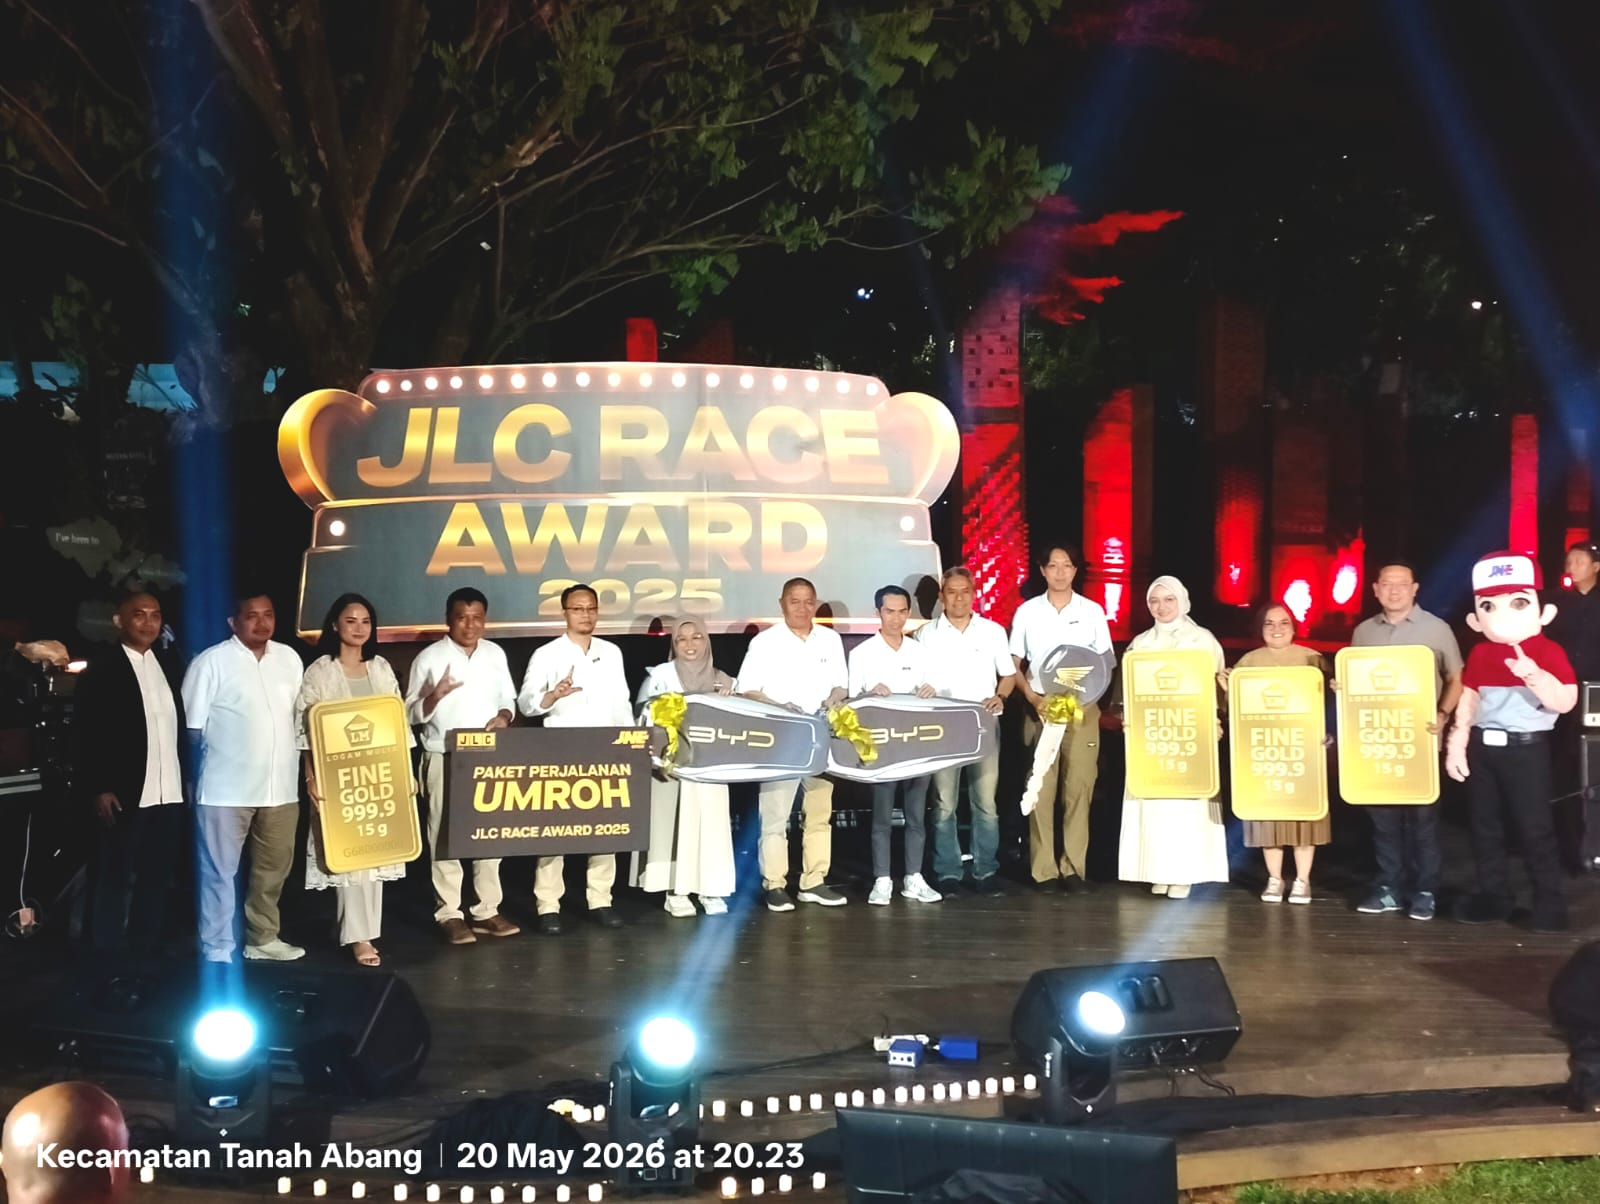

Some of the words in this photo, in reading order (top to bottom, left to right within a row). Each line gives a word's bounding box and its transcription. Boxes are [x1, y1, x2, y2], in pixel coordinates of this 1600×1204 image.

[356, 403, 572, 487] JLC
[600, 404, 890, 485] RACE
[425, 501, 828, 574] AWARD
[538, 578, 724, 616] 2025
[1144, 708, 1196, 727] FINE
[1359, 708, 1415, 728] FINE
[350, 729, 370, 744] LM
[460, 735, 491, 745] JLC
[688, 725, 775, 748] BYD
[870, 725, 944, 745] BYD
[1144, 726, 1197, 742] GOLD
[1250, 727, 1305, 746] FINE
[1359, 727, 1416, 744] GOLD
[326, 751, 361, 762] LOGAM
[1145, 741, 1197, 757] 999.9
[1250, 746, 1305, 762] GOLD
[1359, 743, 1416, 760] 999.9
[473, 766, 526, 779] PAKET
[529, 764, 632, 778] PERJALANAN
[1158, 759, 1175, 771] 15
[1177, 761, 1188, 773] g
[1251, 761, 1305, 777] 999.9
[1374, 763, 1393, 774] 15
[1394, 764, 1405, 777] g
[338, 762, 392, 789] FINE
[340, 783, 394, 805] GOLD
[473, 778, 631, 812] UMROH
[1264, 779, 1282, 791] 15
[1284, 781, 1295, 794] g
[342, 799, 396, 823] 999.9
[357, 824, 375, 837] 15
[378, 823, 388, 837] g
[471, 827, 499, 840] JLC
[501, 826, 539, 839] RACE
[541, 825, 593, 838] AWARD
[594, 824, 630, 836] 2025
